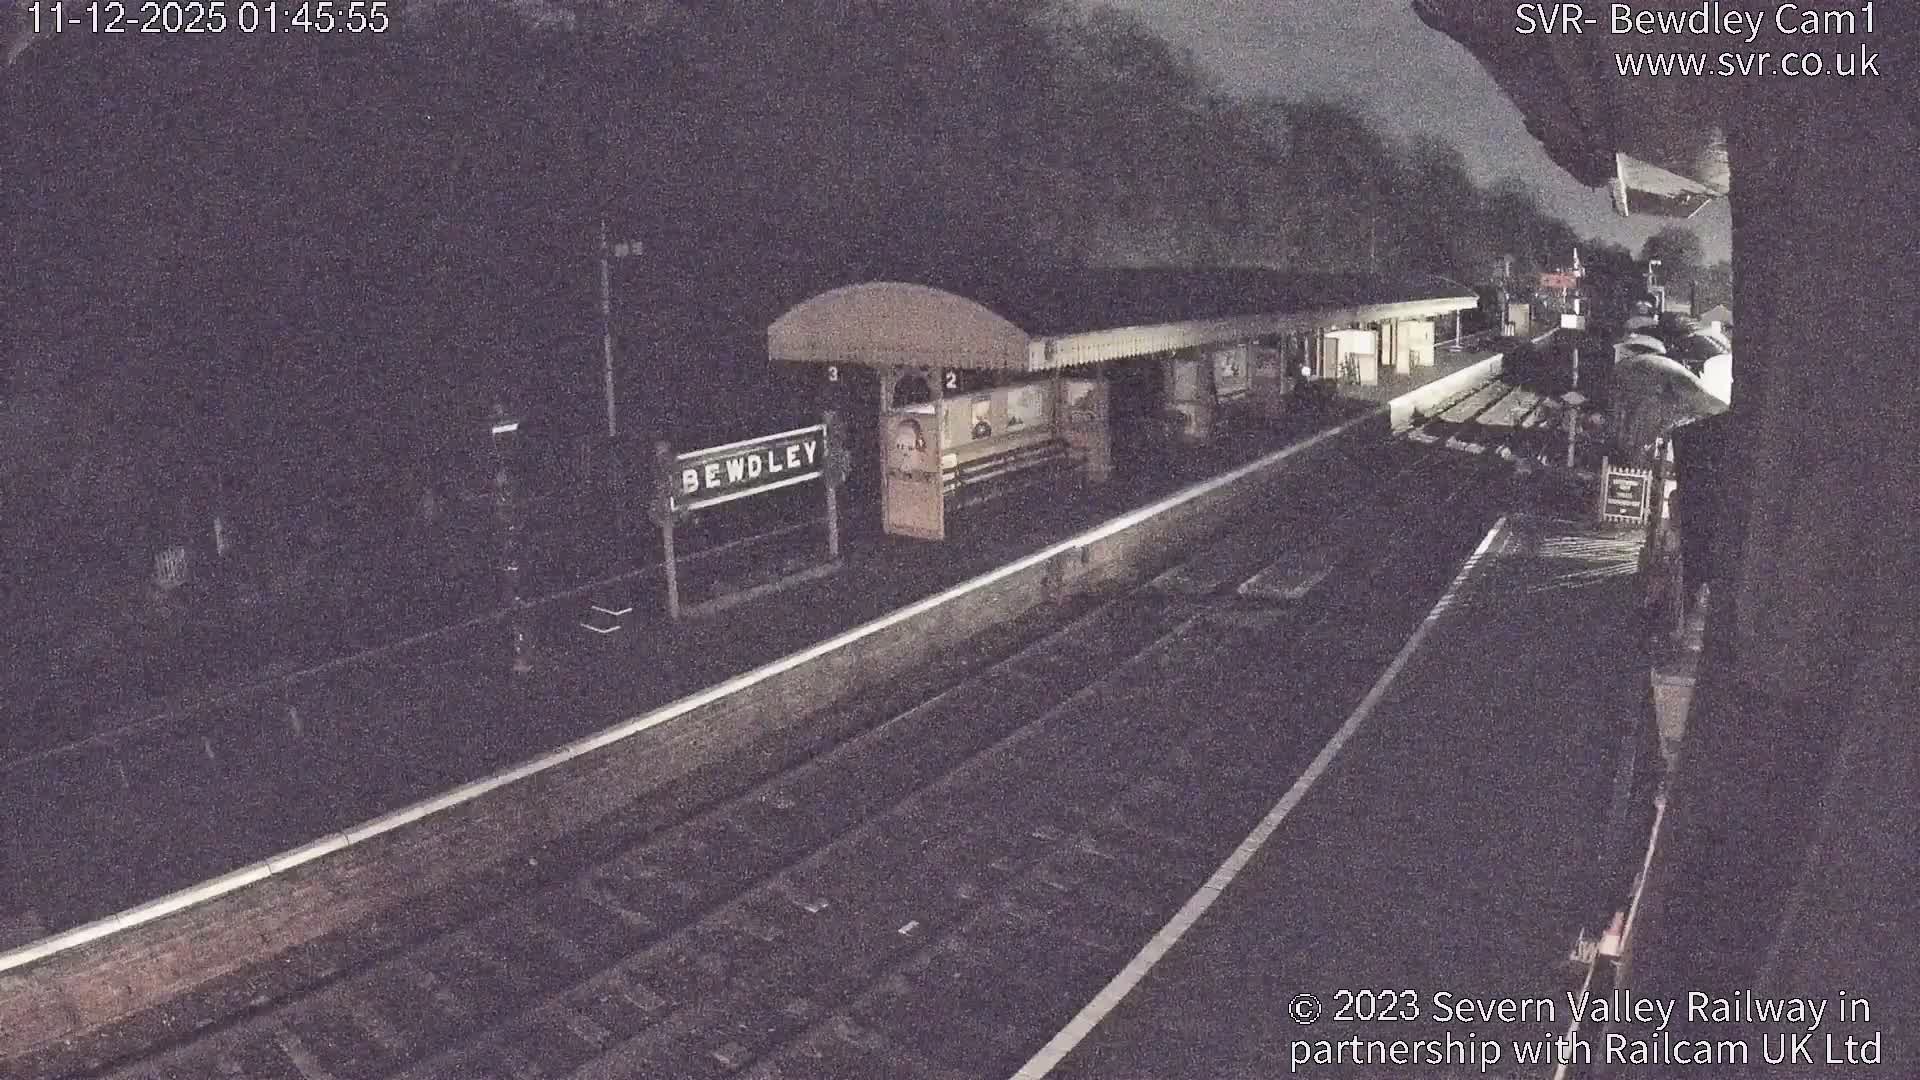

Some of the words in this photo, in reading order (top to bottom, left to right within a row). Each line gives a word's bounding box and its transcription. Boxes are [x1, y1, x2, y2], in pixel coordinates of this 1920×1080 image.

[828, 366, 838, 381] 3
[946, 372, 957, 389] 2
[682, 441, 817, 494] BEWDLEY
